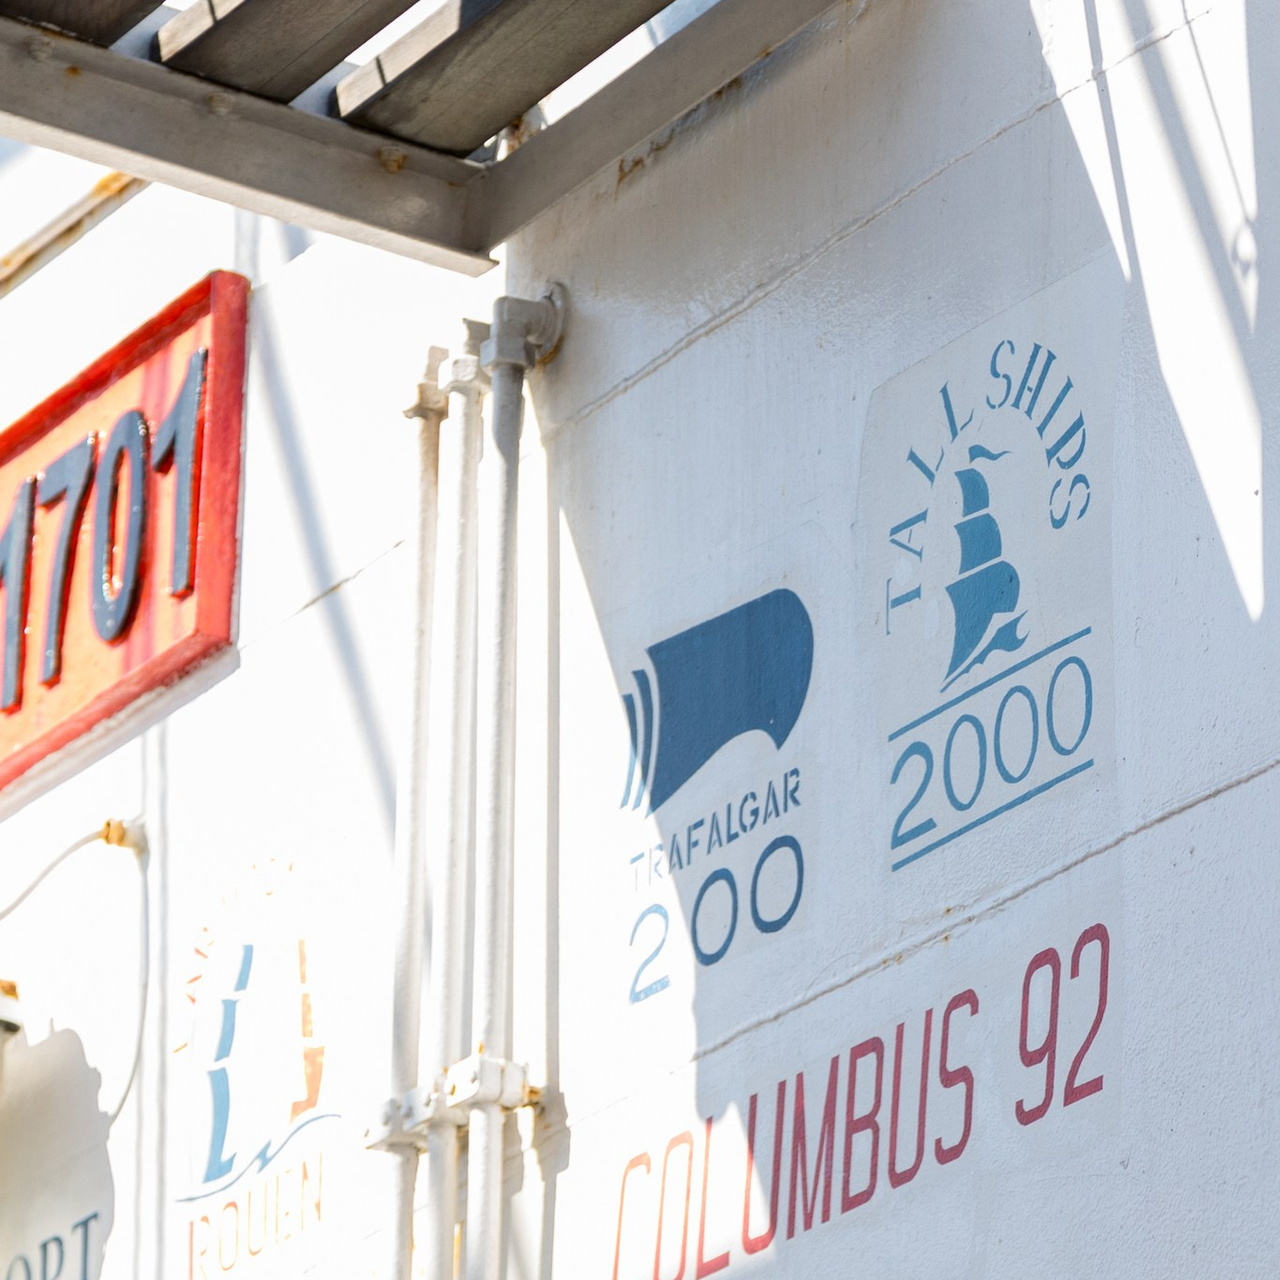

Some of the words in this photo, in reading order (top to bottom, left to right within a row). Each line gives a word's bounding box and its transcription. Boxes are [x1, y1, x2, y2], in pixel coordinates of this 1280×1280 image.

[885, 380, 974, 635] TALL
[985, 338, 1091, 530] SHIPS
[629, 766, 802, 893] TRAFALGAR
[889, 655, 1093, 851] 2000
[629, 834, 805, 1005] 200
[1014, 922, 1110, 1127] 92
